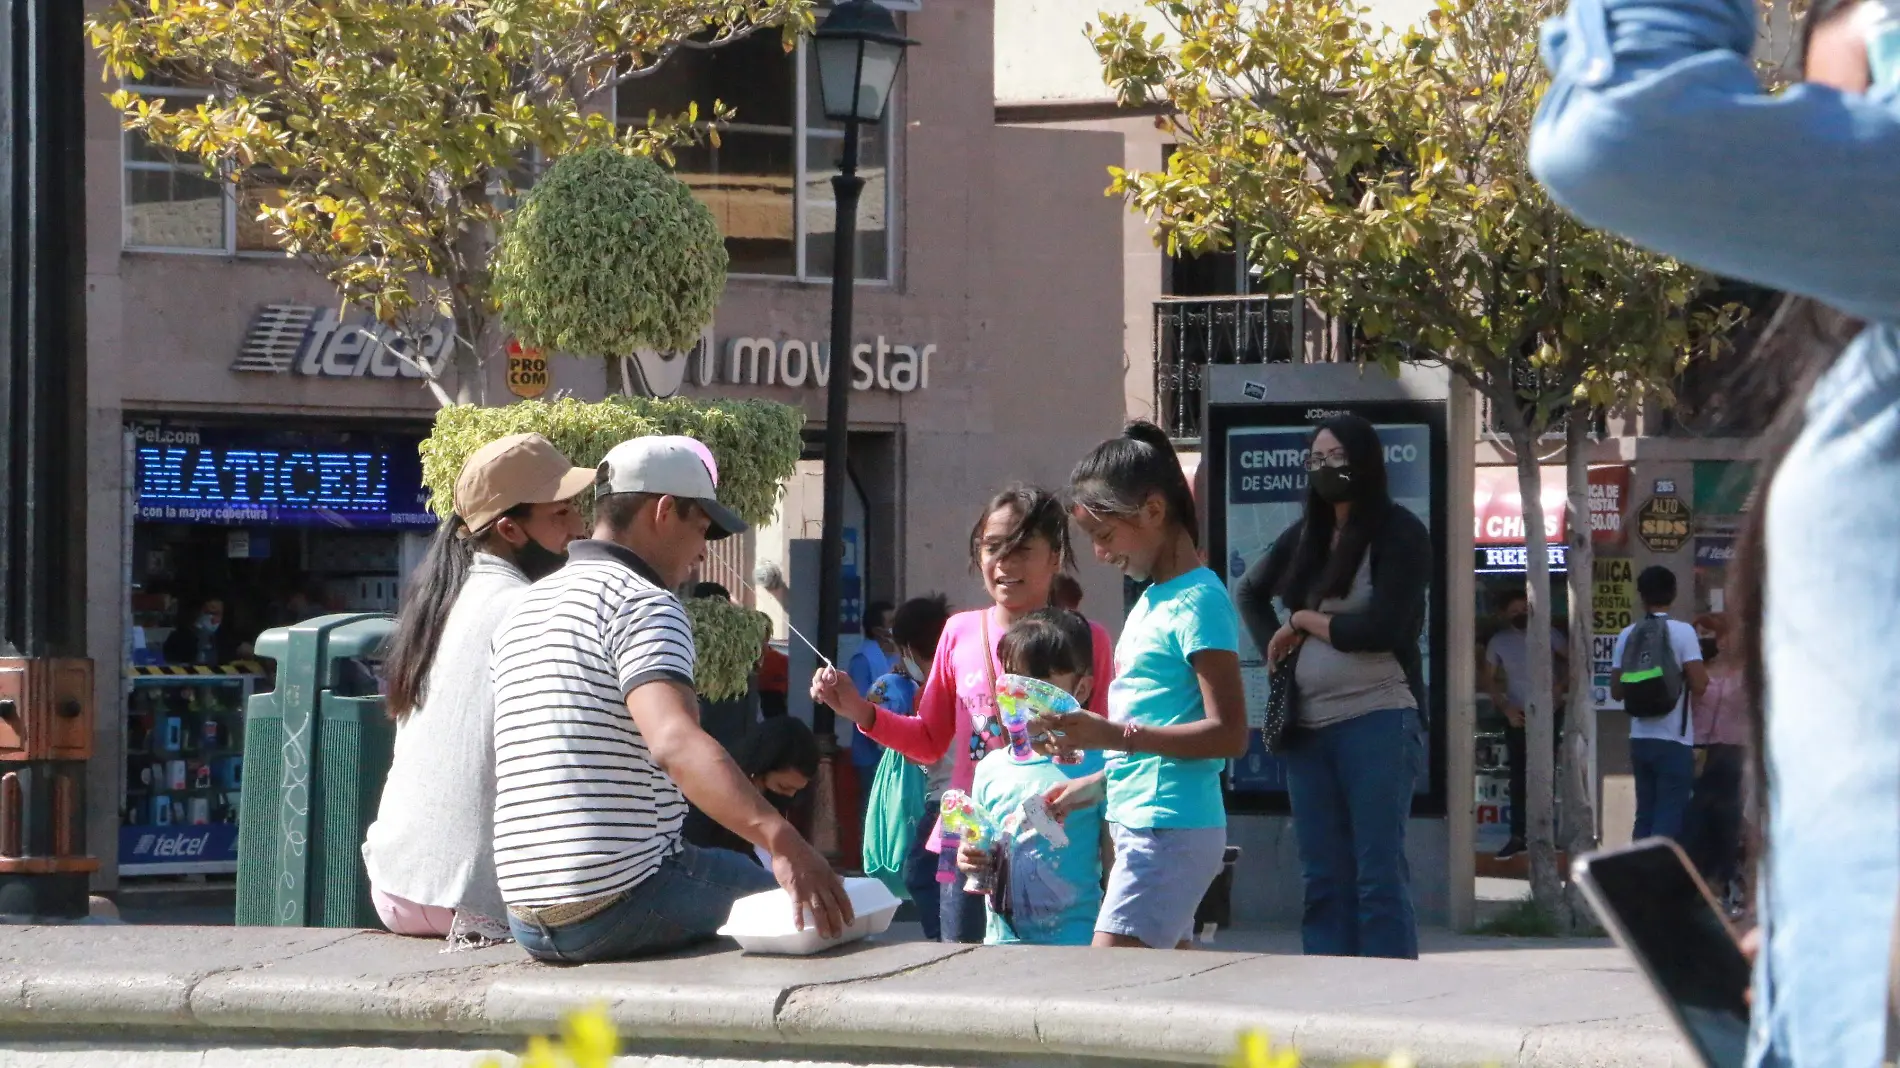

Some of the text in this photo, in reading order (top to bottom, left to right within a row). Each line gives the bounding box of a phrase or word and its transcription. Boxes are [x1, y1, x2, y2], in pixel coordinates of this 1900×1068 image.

[510, 358, 546, 371] PRO
[729, 335, 937, 393] movstar
[510, 372, 546, 384] COM
[1242, 475, 1261, 491] DE
[1263, 474, 1293, 490] SAN
[142, 506, 163, 518] con
[165, 505, 176, 518] la
[179, 507, 213, 521] mayor
[1651, 499, 1678, 514] ALTO
[1591, 513, 1620, 531] 50.00
[1600, 585, 1624, 594] DE
[153, 832, 209, 857] telcel
